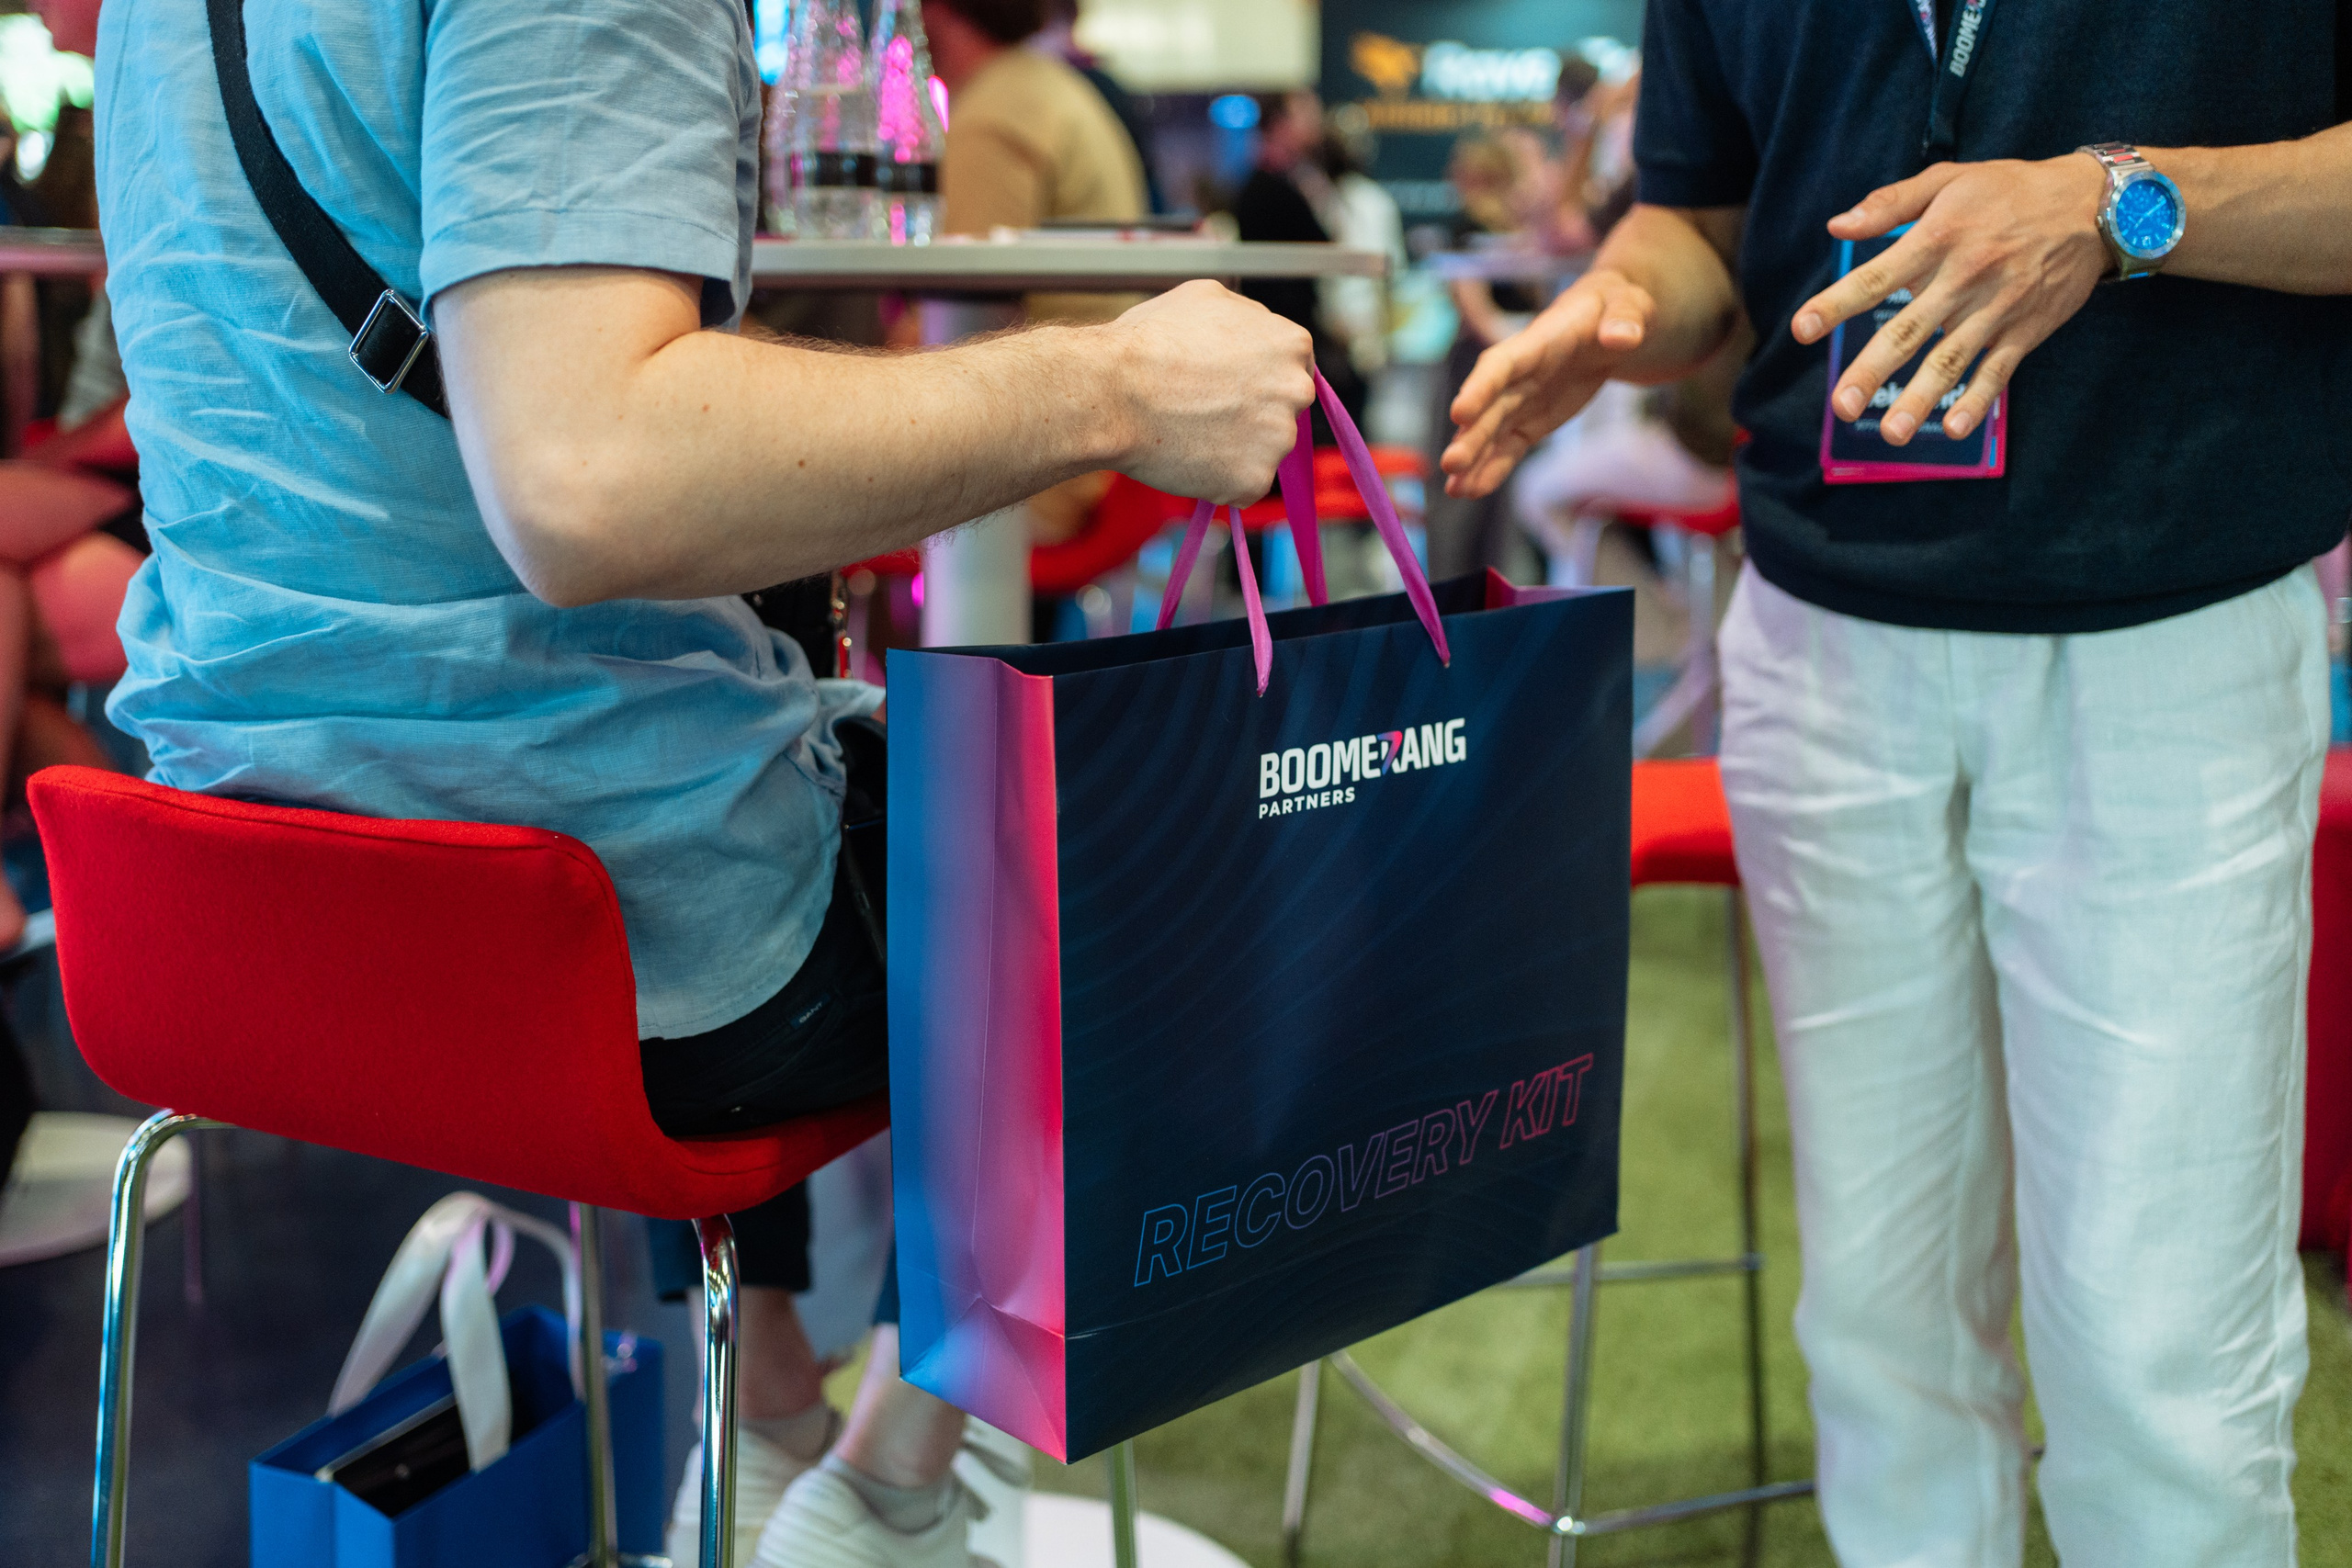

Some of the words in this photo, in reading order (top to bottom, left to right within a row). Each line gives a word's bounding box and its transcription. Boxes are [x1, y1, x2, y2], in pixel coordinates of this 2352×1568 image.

[1260, 717, 1466, 798] BOOMERANG
[1259, 786, 1355, 818] PARTNERS
[1135, 1089, 1499, 1287] RECOVERY
[1499, 1053, 1594, 1150] KIT
